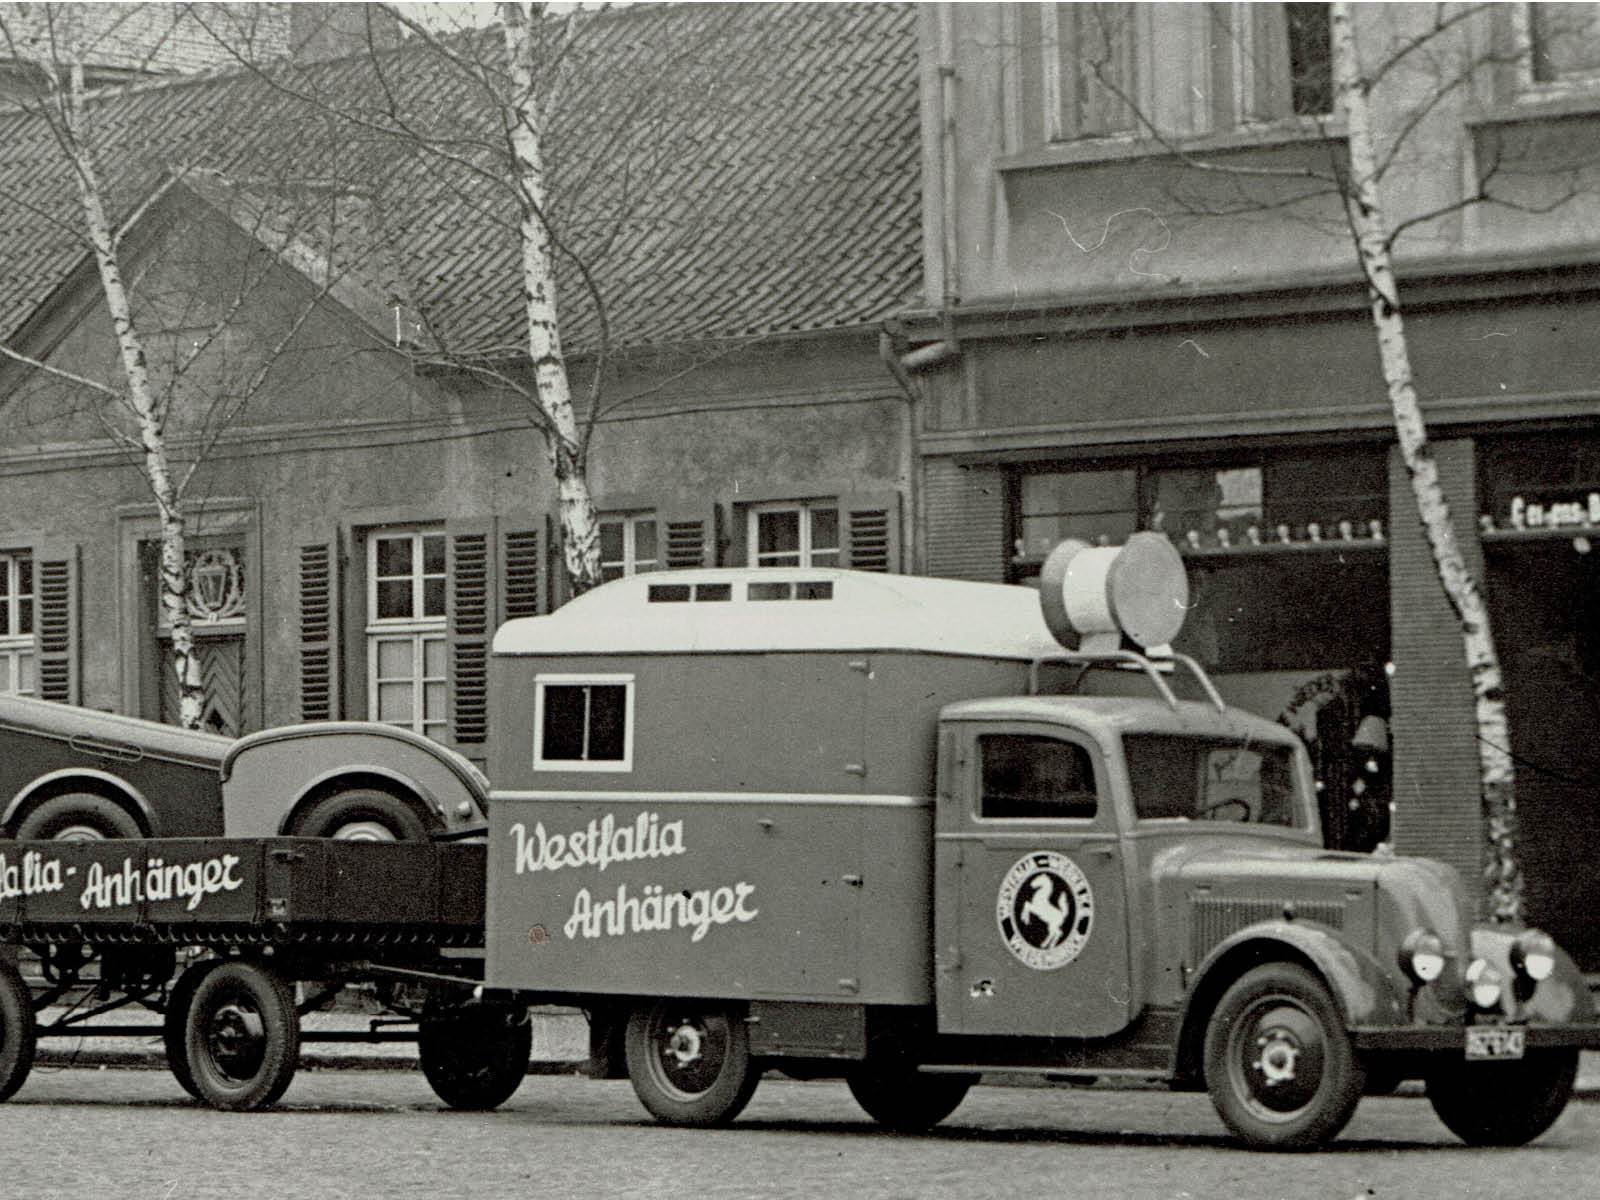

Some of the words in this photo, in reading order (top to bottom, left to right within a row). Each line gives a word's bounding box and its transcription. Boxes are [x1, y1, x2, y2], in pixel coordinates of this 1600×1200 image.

[510, 811, 686, 874] Westfalia
[80, 854, 243, 911] Anhänger
[563, 881, 758, 942] Anhänger
